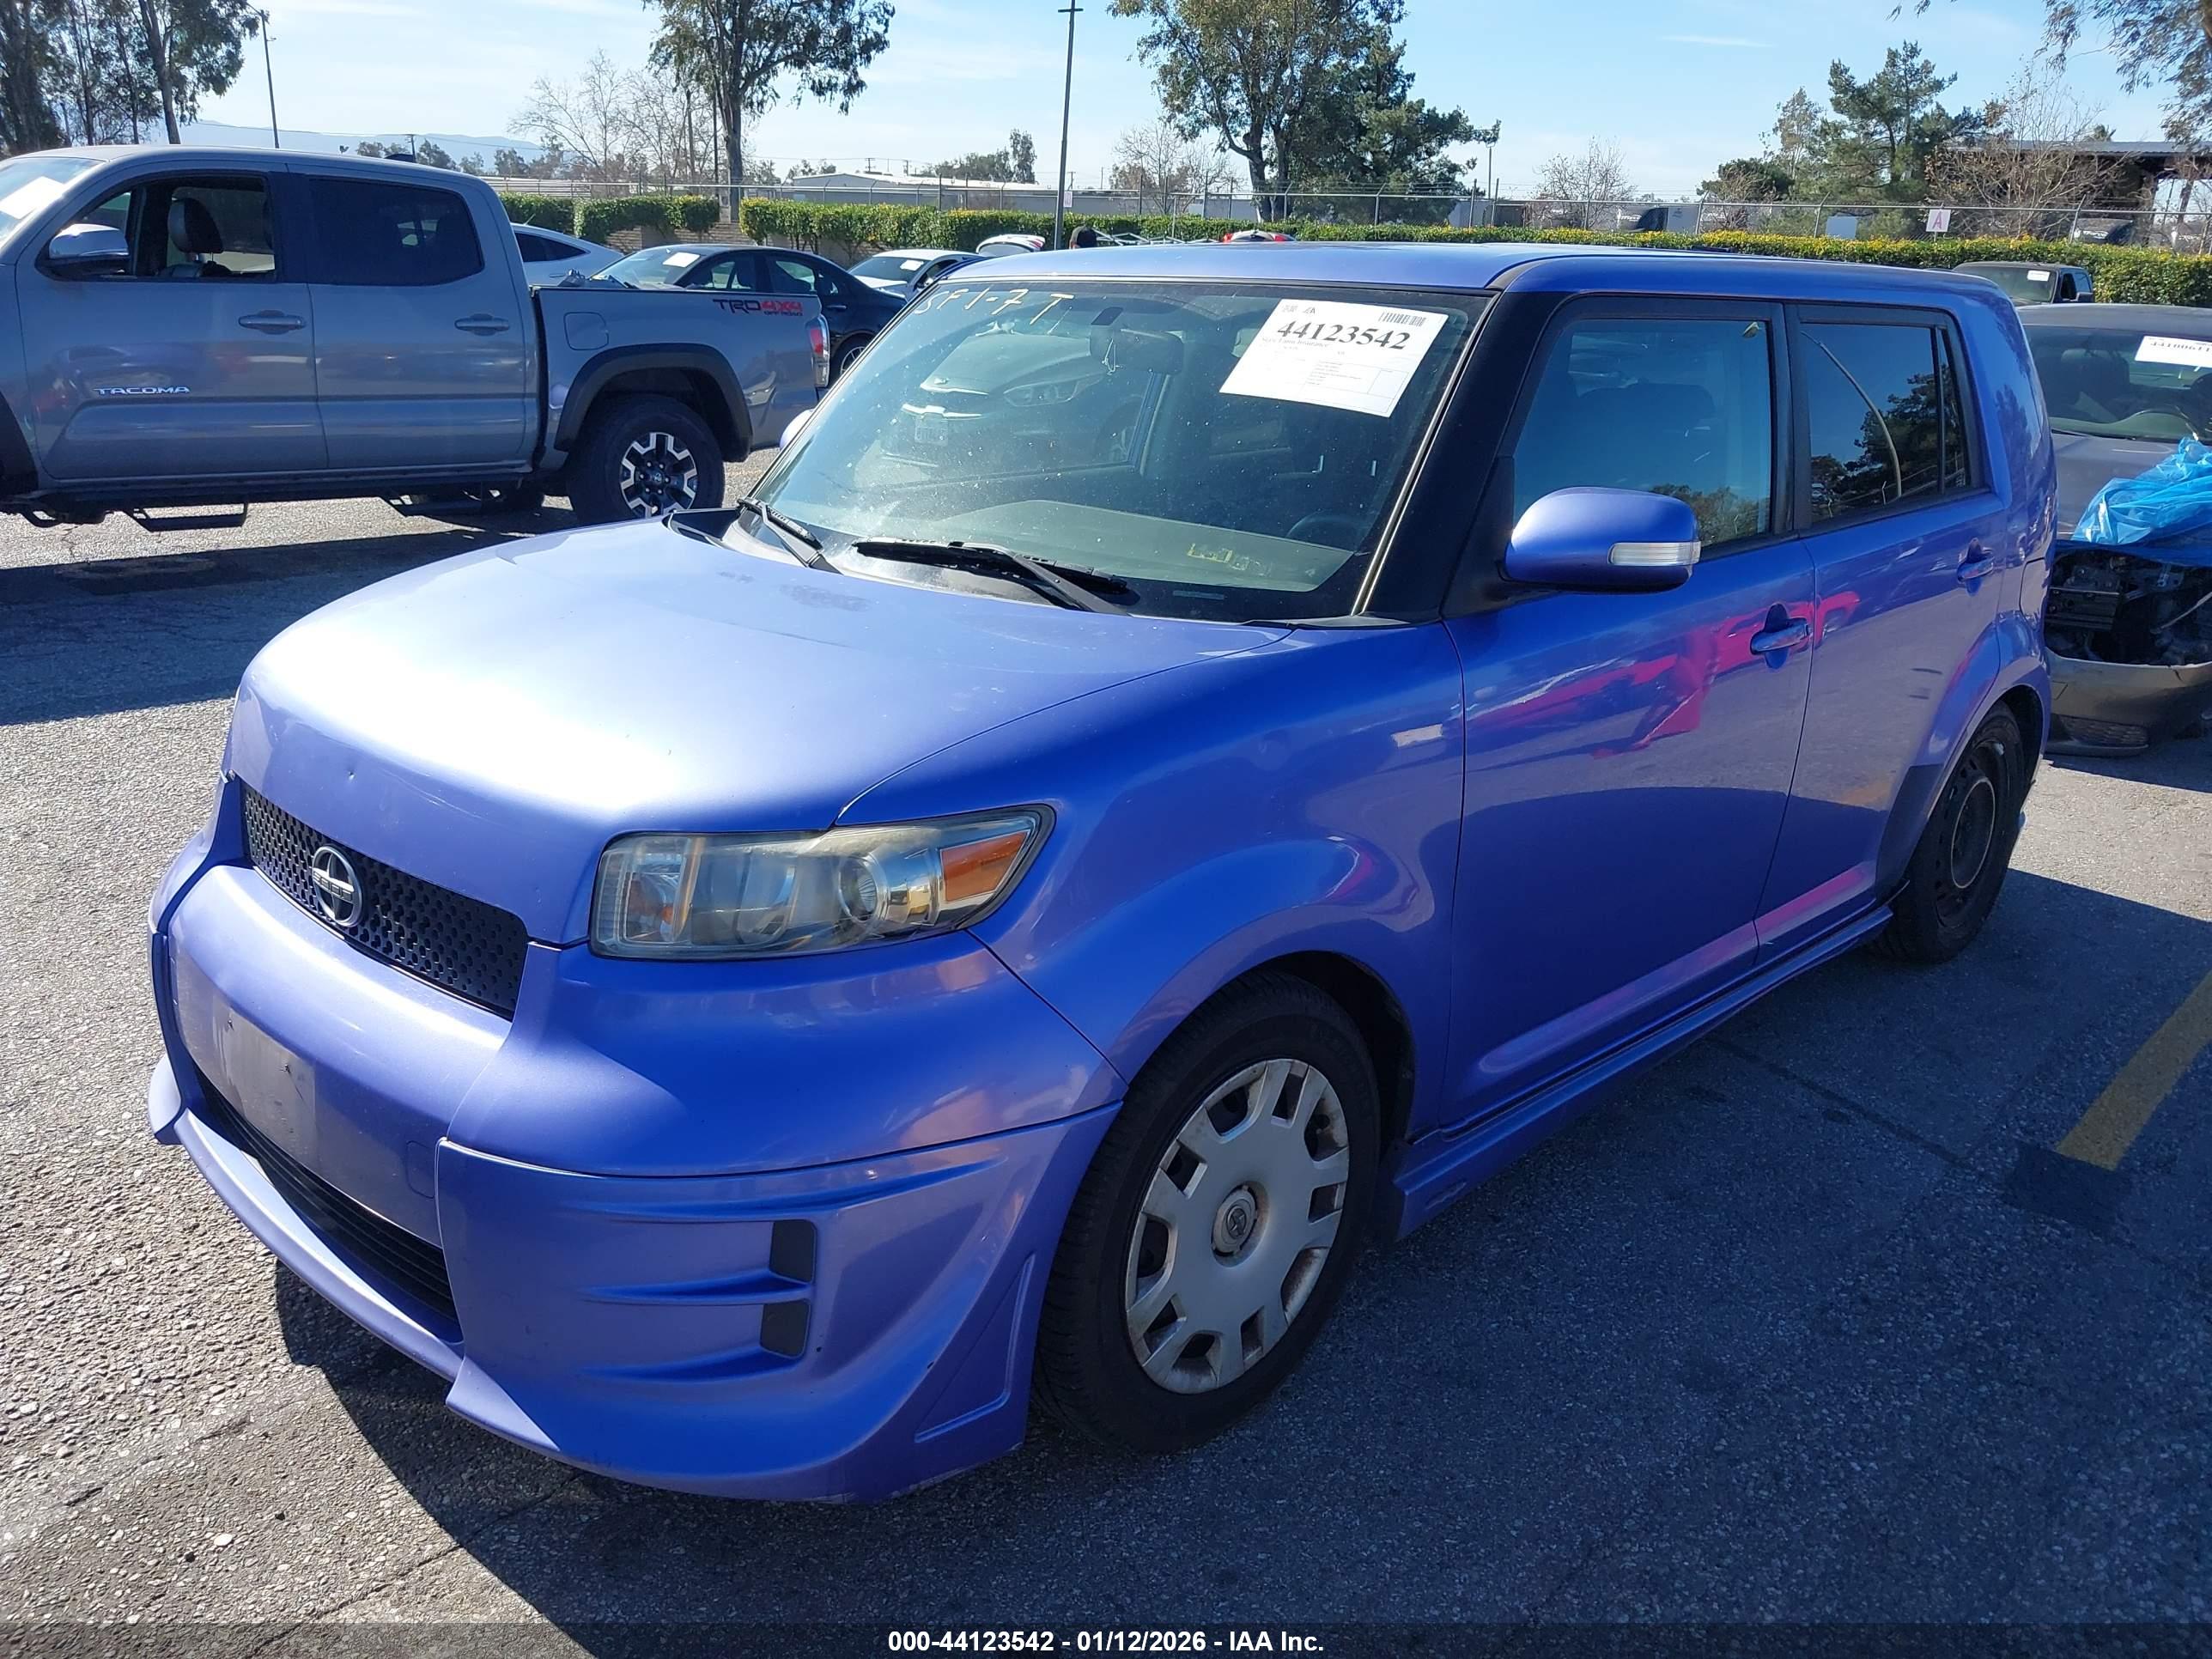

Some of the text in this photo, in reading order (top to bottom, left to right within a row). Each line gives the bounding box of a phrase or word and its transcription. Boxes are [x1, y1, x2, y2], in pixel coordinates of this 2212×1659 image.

[1932, 210, 1942, 230] A
[1277, 320, 1411, 350] 44123542
[93, 386, 191, 395] TACOMA
